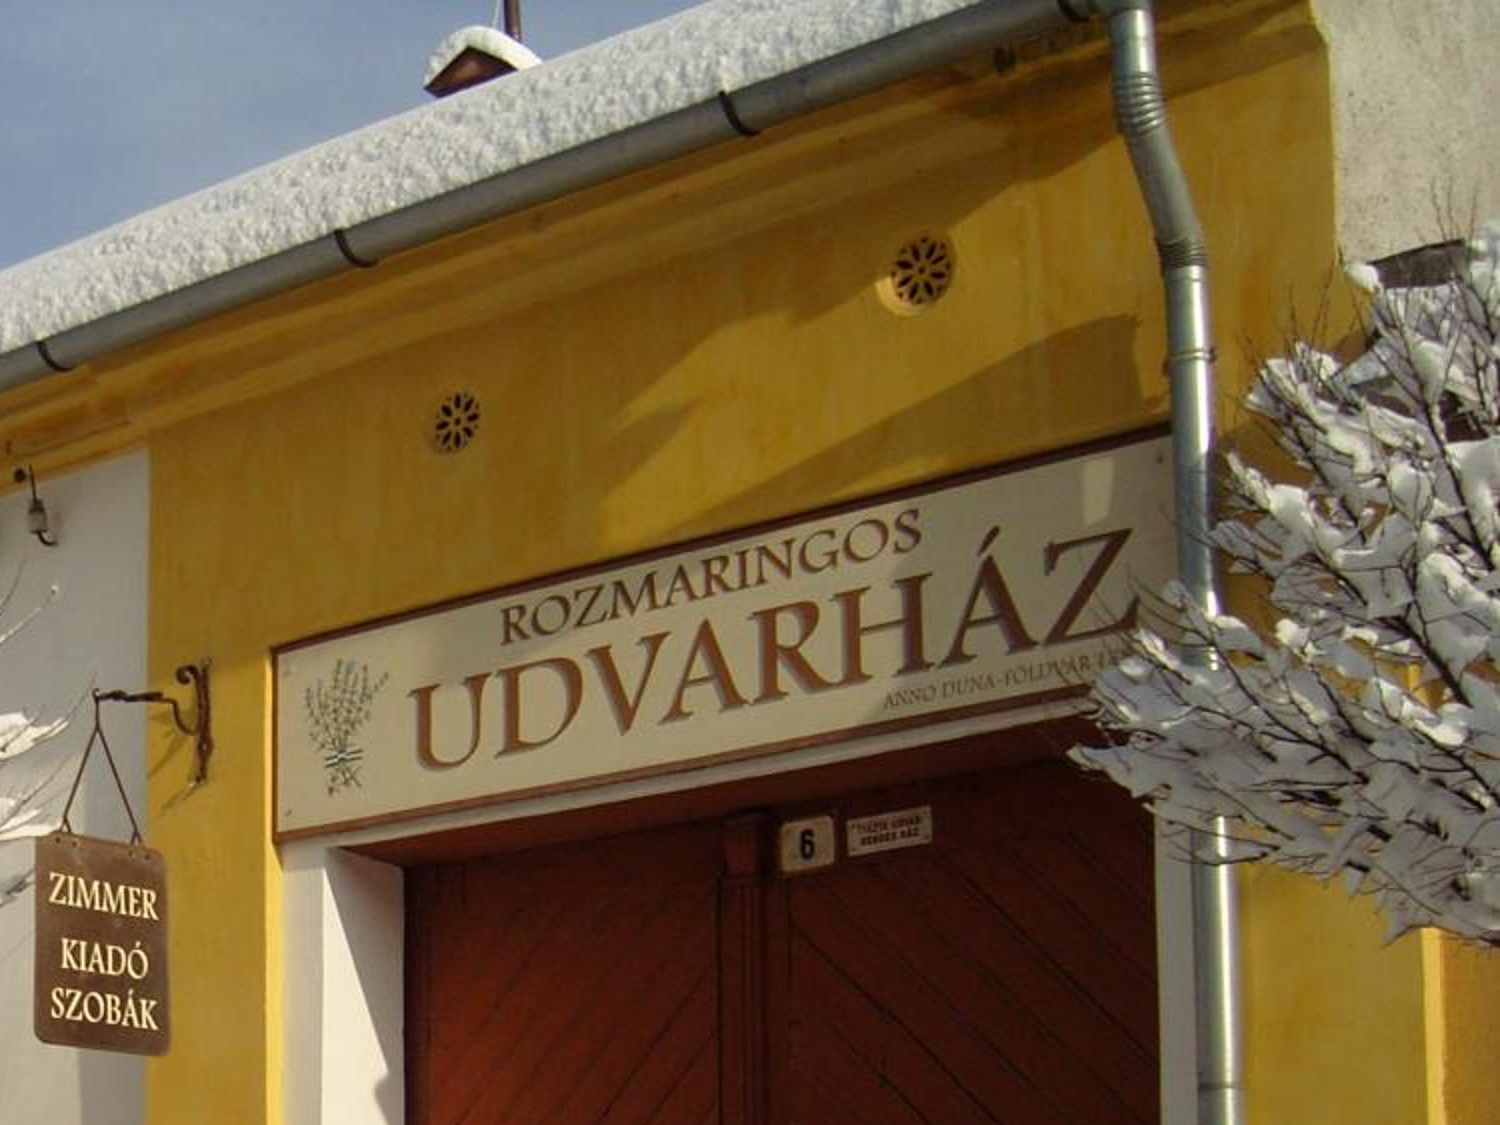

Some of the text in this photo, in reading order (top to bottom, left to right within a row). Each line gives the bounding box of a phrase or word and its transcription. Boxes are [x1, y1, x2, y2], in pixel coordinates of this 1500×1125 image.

[499, 508, 922, 646] ROZMARINGOS
[406, 525, 1140, 772] UDVARHÁZ
[883, 684, 937, 710] ANNO
[800, 828, 816, 860] 6
[49, 872, 160, 921] ZIMMER
[60, 938, 149, 980] KIADÓ
[51, 987, 159, 1031] SZOBÁK
